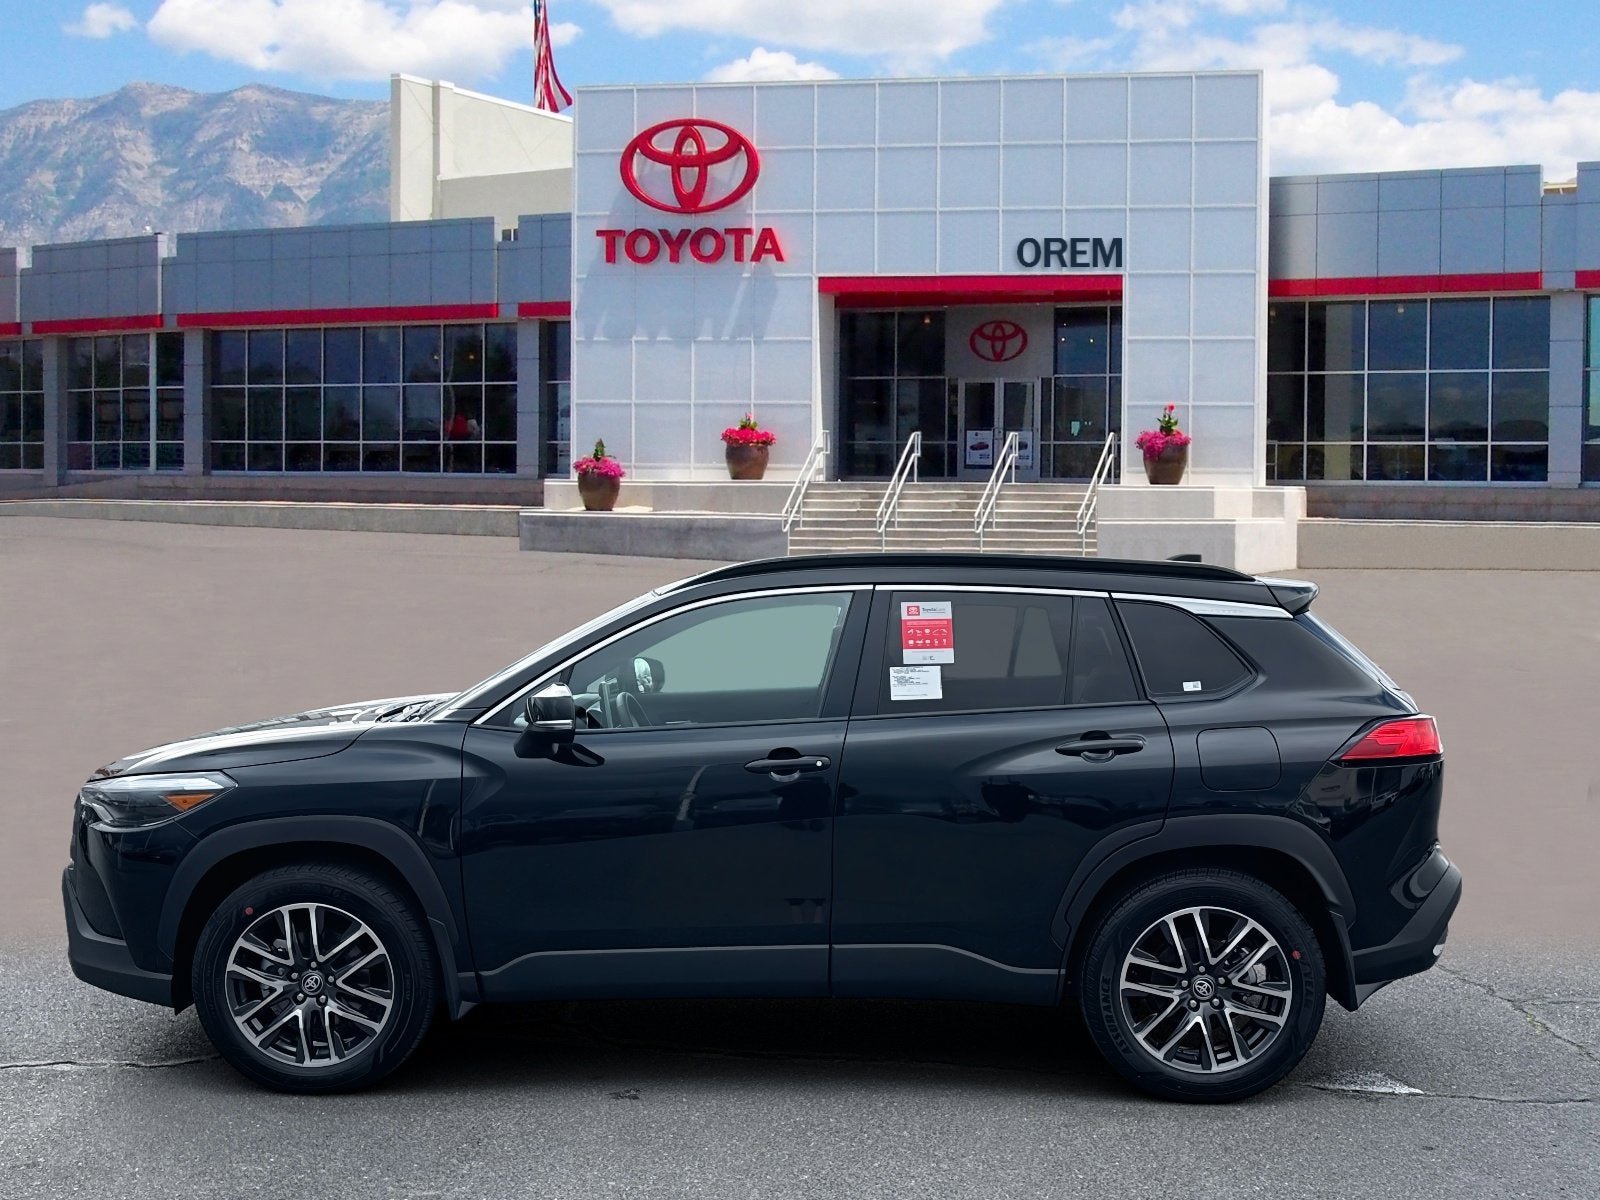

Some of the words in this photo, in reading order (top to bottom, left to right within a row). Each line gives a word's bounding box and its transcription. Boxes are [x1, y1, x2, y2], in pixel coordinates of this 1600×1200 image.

[596, 227, 784, 264] TOYOTA
[1017, 237, 1123, 268] OREM
[1101, 975, 1133, 1055] ASSURANCE
